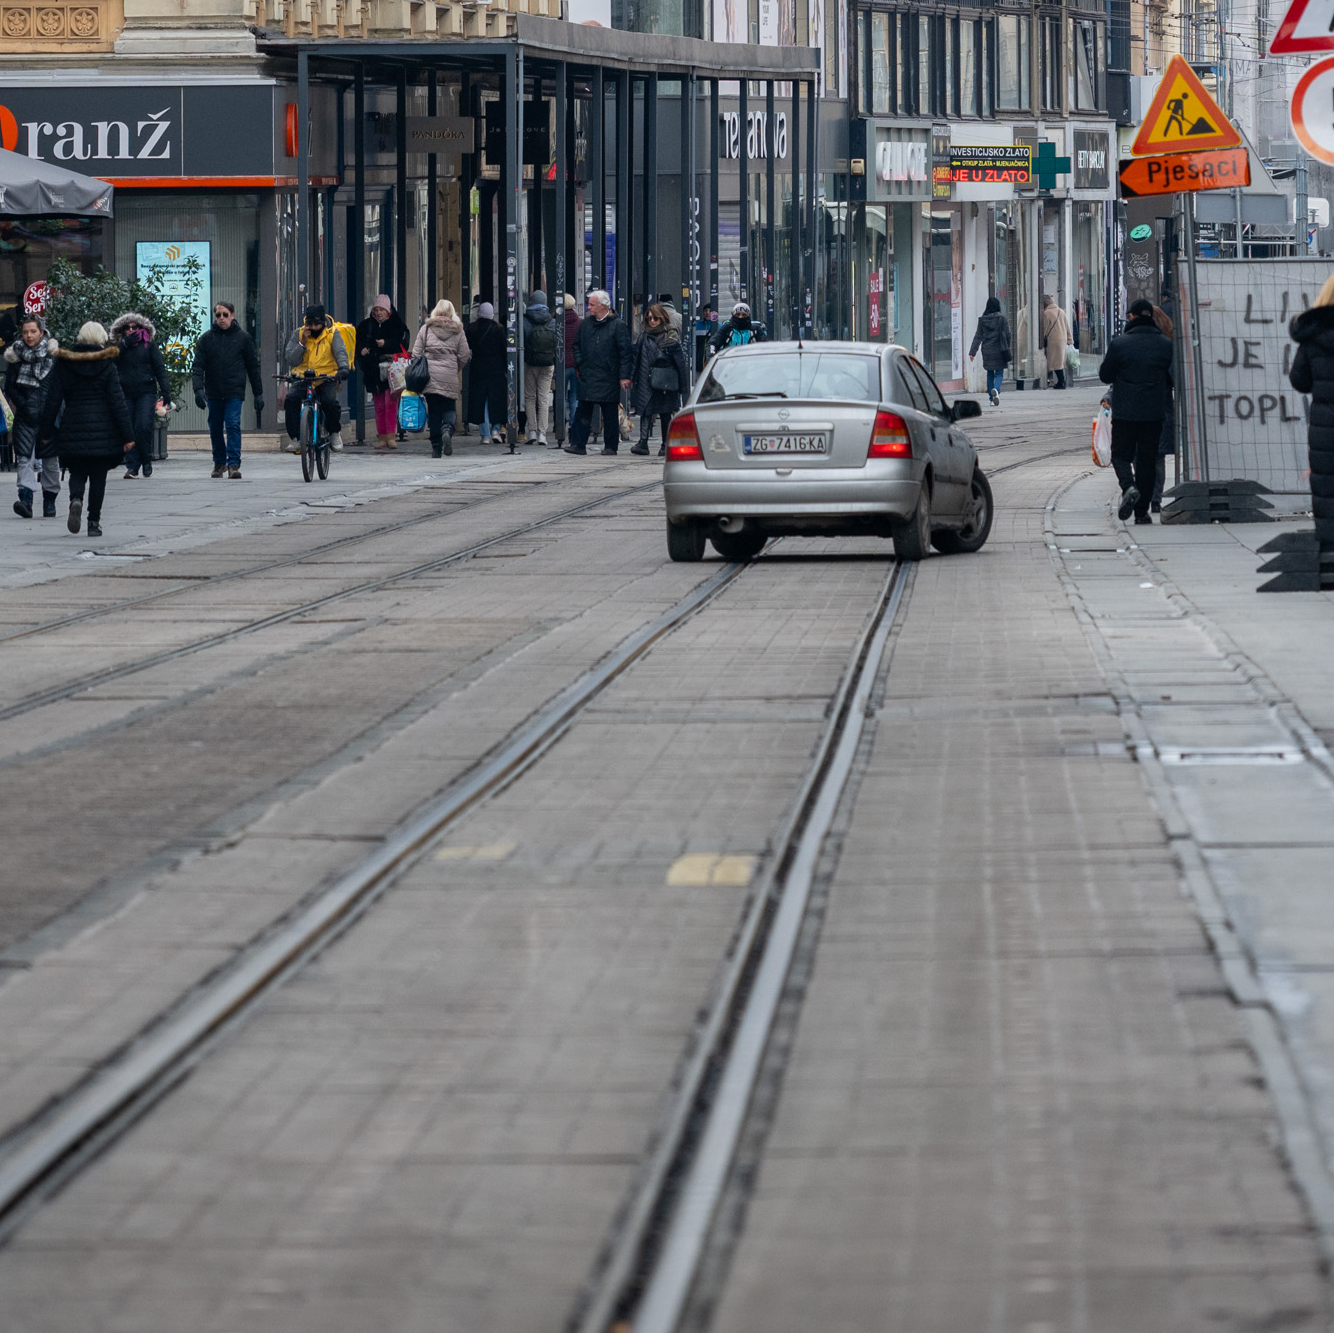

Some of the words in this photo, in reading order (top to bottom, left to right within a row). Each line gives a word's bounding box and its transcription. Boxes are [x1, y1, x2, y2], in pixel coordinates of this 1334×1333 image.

[950, 147, 1004, 157] INVESTICIJSKO
[1006, 147, 1029, 157] ZLATO
[972, 169, 982, 182] U
[984, 169, 1028, 182] ZLATO
[1147, 155, 1239, 188] Pješaci
[1217, 337, 1264, 369] JE
[752, 438, 768, 451] ZG
